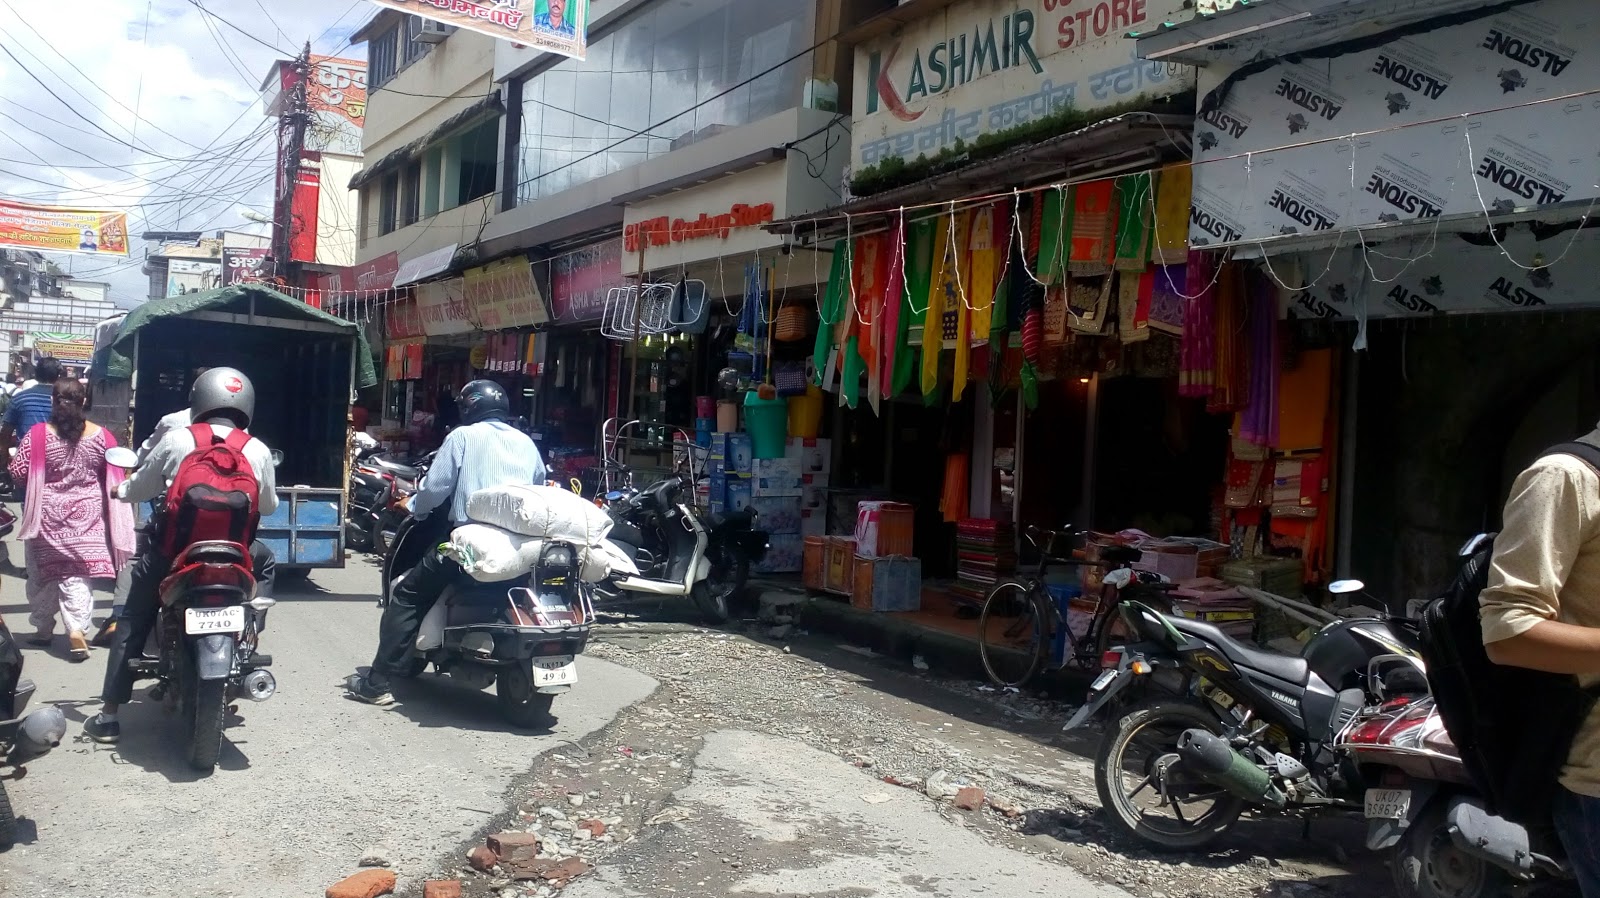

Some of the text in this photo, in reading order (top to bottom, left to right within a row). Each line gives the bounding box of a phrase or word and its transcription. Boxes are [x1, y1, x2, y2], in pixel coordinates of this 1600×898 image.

[1057, 0, 1147, 48] STORE
[865, 9, 1043, 121] KASHMIR
[1482, 29, 1572, 77] ALSTONE
[1371, 55, 1448, 100] ALSTONE
[1275, 78, 1342, 120] ALSTONE
[1203, 109, 1249, 139] ALSTO
[1365, 174, 1442, 218] ALSTONE
[1476, 157, 1566, 205] ALSTONE
[731, 203, 775, 226] Store
[1190, 206, 1242, 242] ALSTON
[1268, 189, 1335, 231] ALSTONE
[198, 620, 232, 629] 7740
[542, 672, 566, 681] 490
[1271, 691, 1297, 707] YAMAHA
